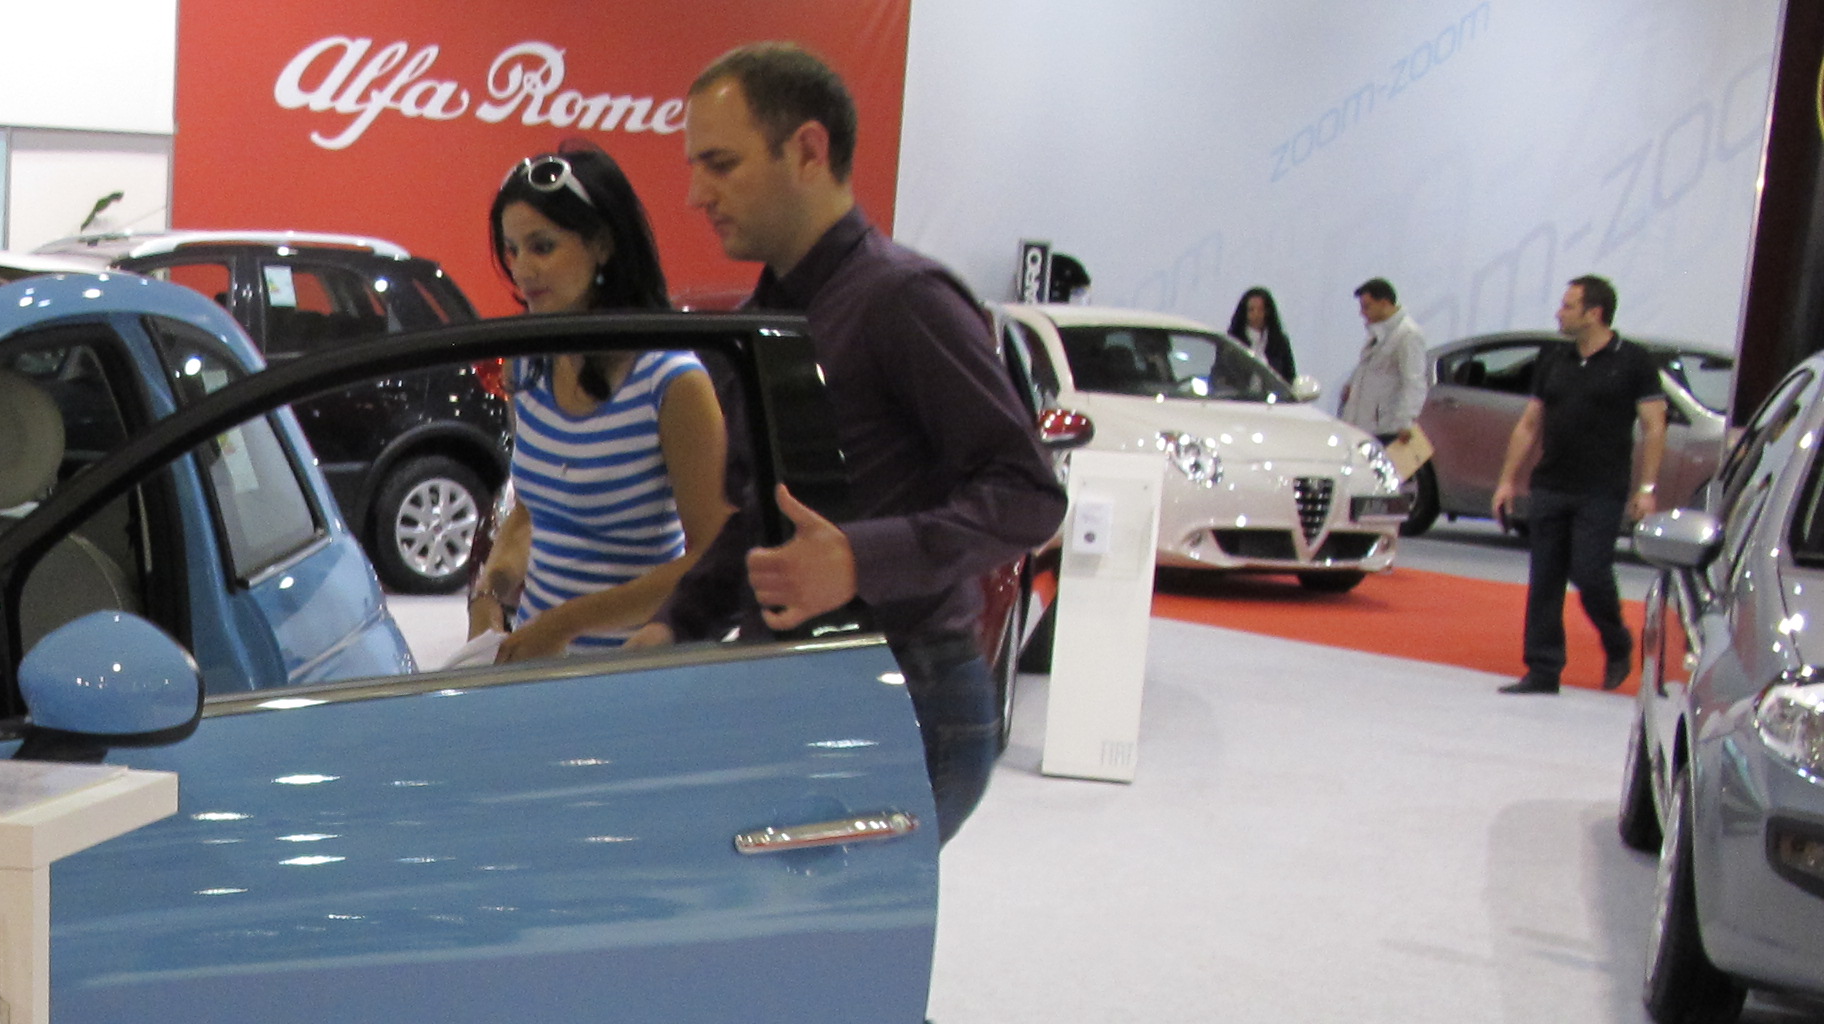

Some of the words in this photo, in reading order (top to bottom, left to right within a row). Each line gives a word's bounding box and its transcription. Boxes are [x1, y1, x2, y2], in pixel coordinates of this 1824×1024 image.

[274, 35, 470, 150] Alfa
[476, 41, 688, 134] Rome
[1269, 2, 1491, 183] zoom-zoom
